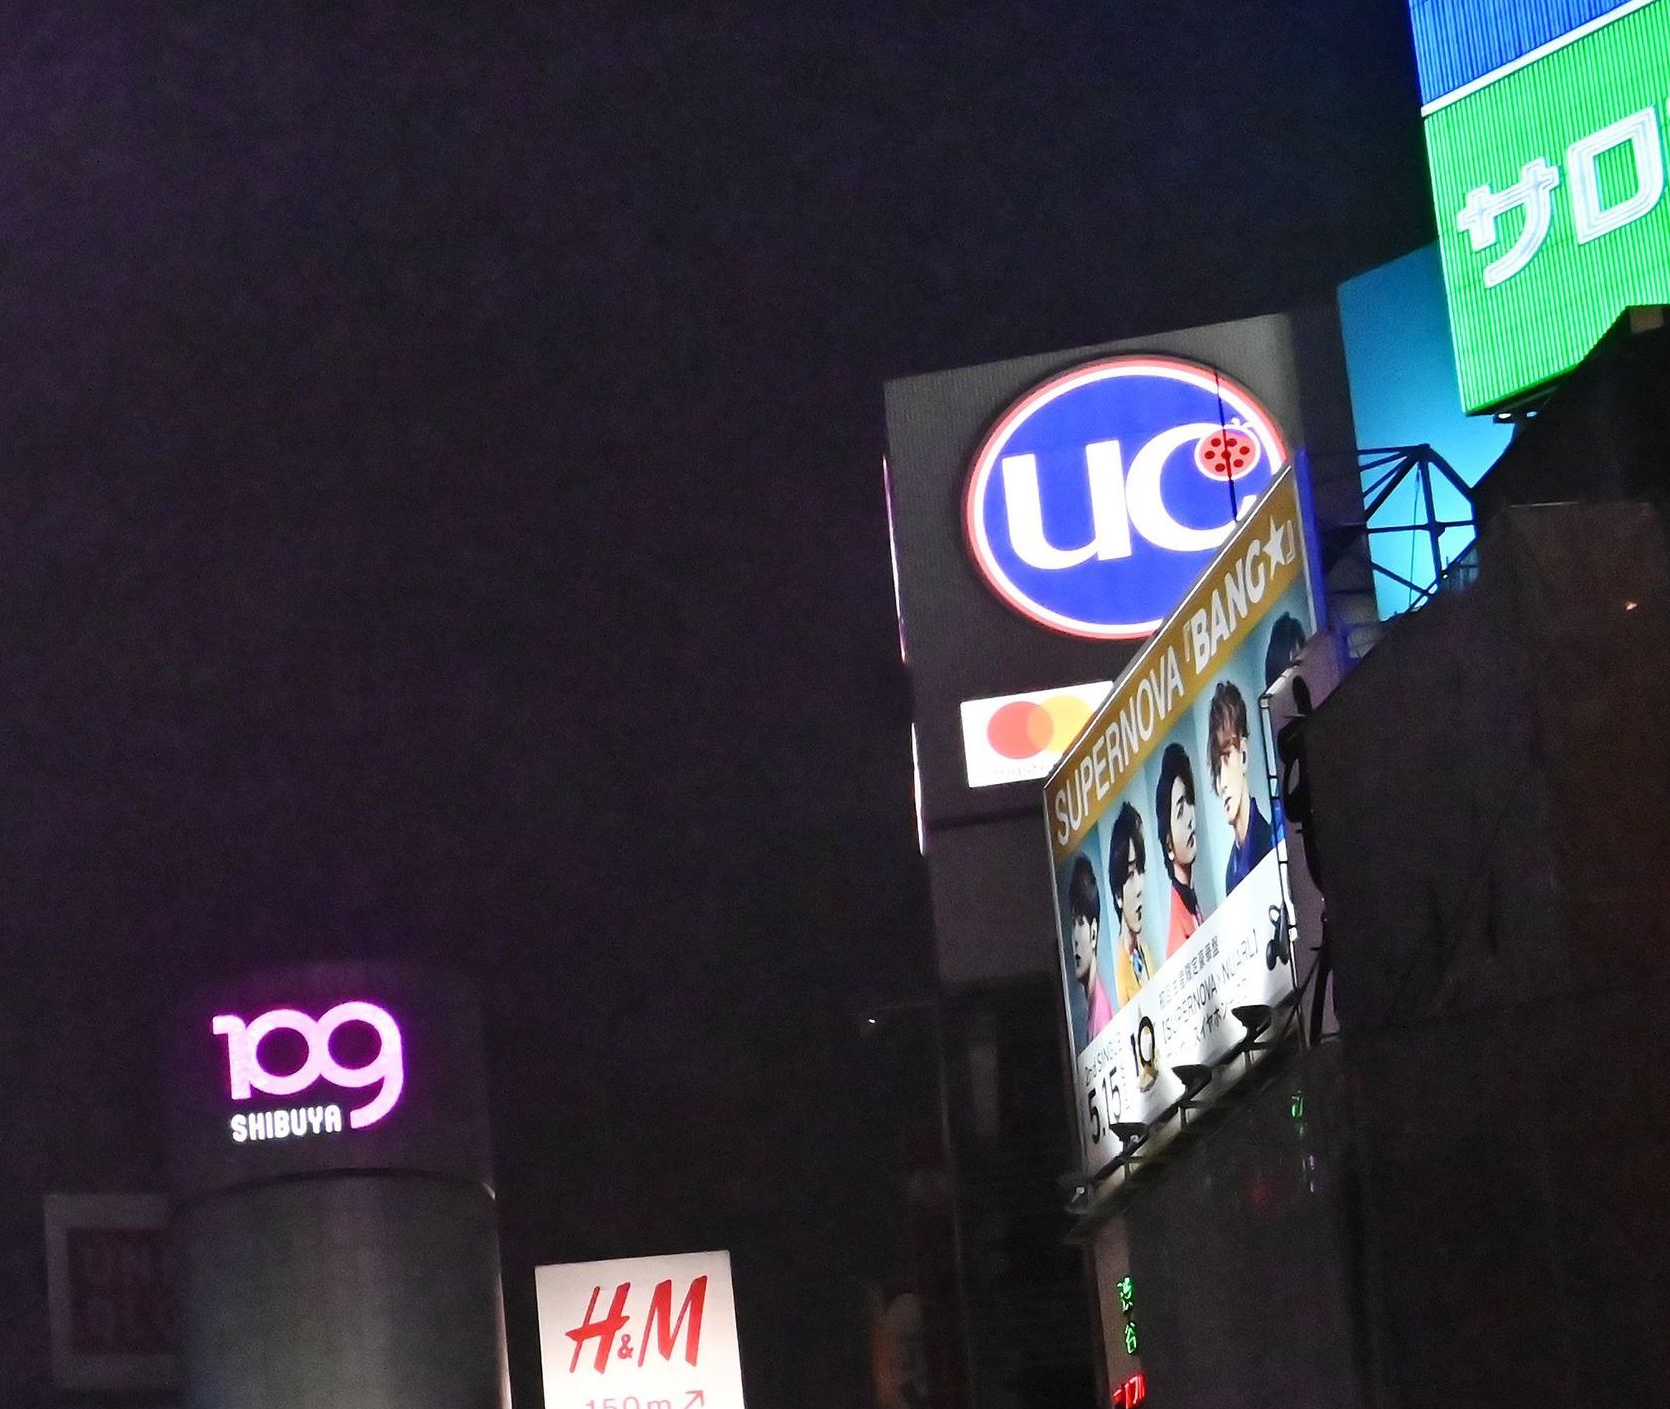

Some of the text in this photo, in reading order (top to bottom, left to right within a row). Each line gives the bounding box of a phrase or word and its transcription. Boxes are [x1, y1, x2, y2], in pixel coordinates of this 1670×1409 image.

[1455, 95, 1670, 290] サロ
[1055, 655, 1184, 848] SUPERNOVA
[211, 1000, 406, 1130] 109
[230, 1104, 343, 1143] SHIBUYA
[565, 1275, 710, 1378] H&M
